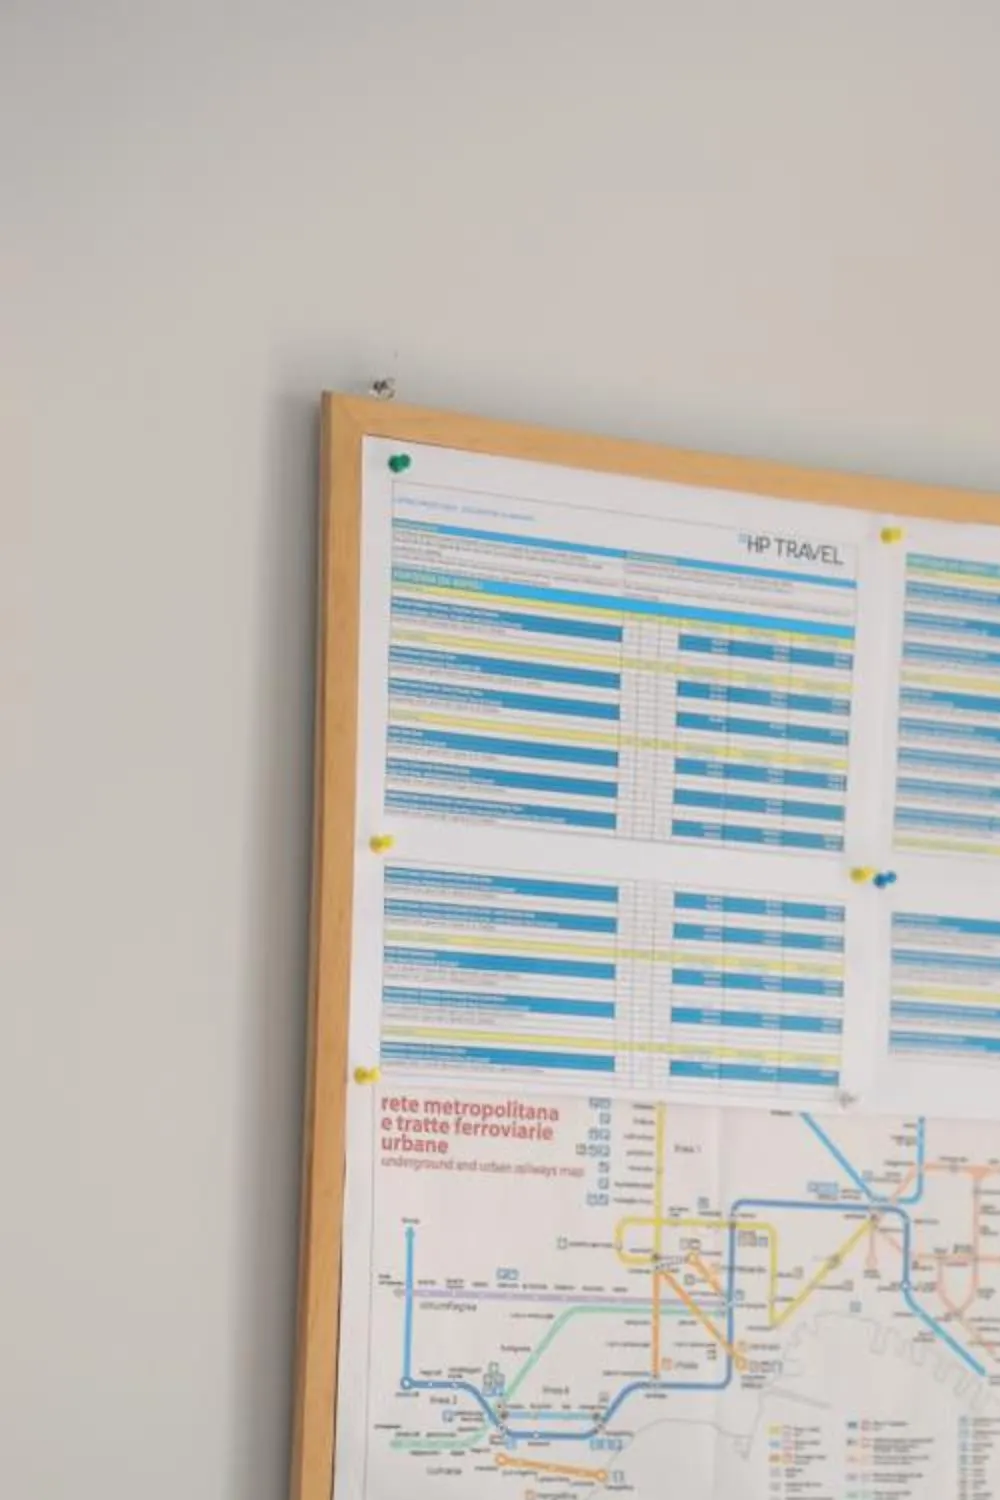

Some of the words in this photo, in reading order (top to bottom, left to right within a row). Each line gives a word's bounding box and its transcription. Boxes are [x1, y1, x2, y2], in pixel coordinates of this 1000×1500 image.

[747, 534, 771, 554] HP
[774, 537, 845, 566] TRAVEL
[381, 1096, 419, 1112] rete
[424, 1097, 559, 1122] metropolitana
[381, 1116, 392, 1131] e
[397, 1115, 449, 1134] tratte
[454, 1117, 553, 1141] ferroviarie
[381, 1134, 449, 1154] urbane
[381, 1156, 453, 1172] underground
